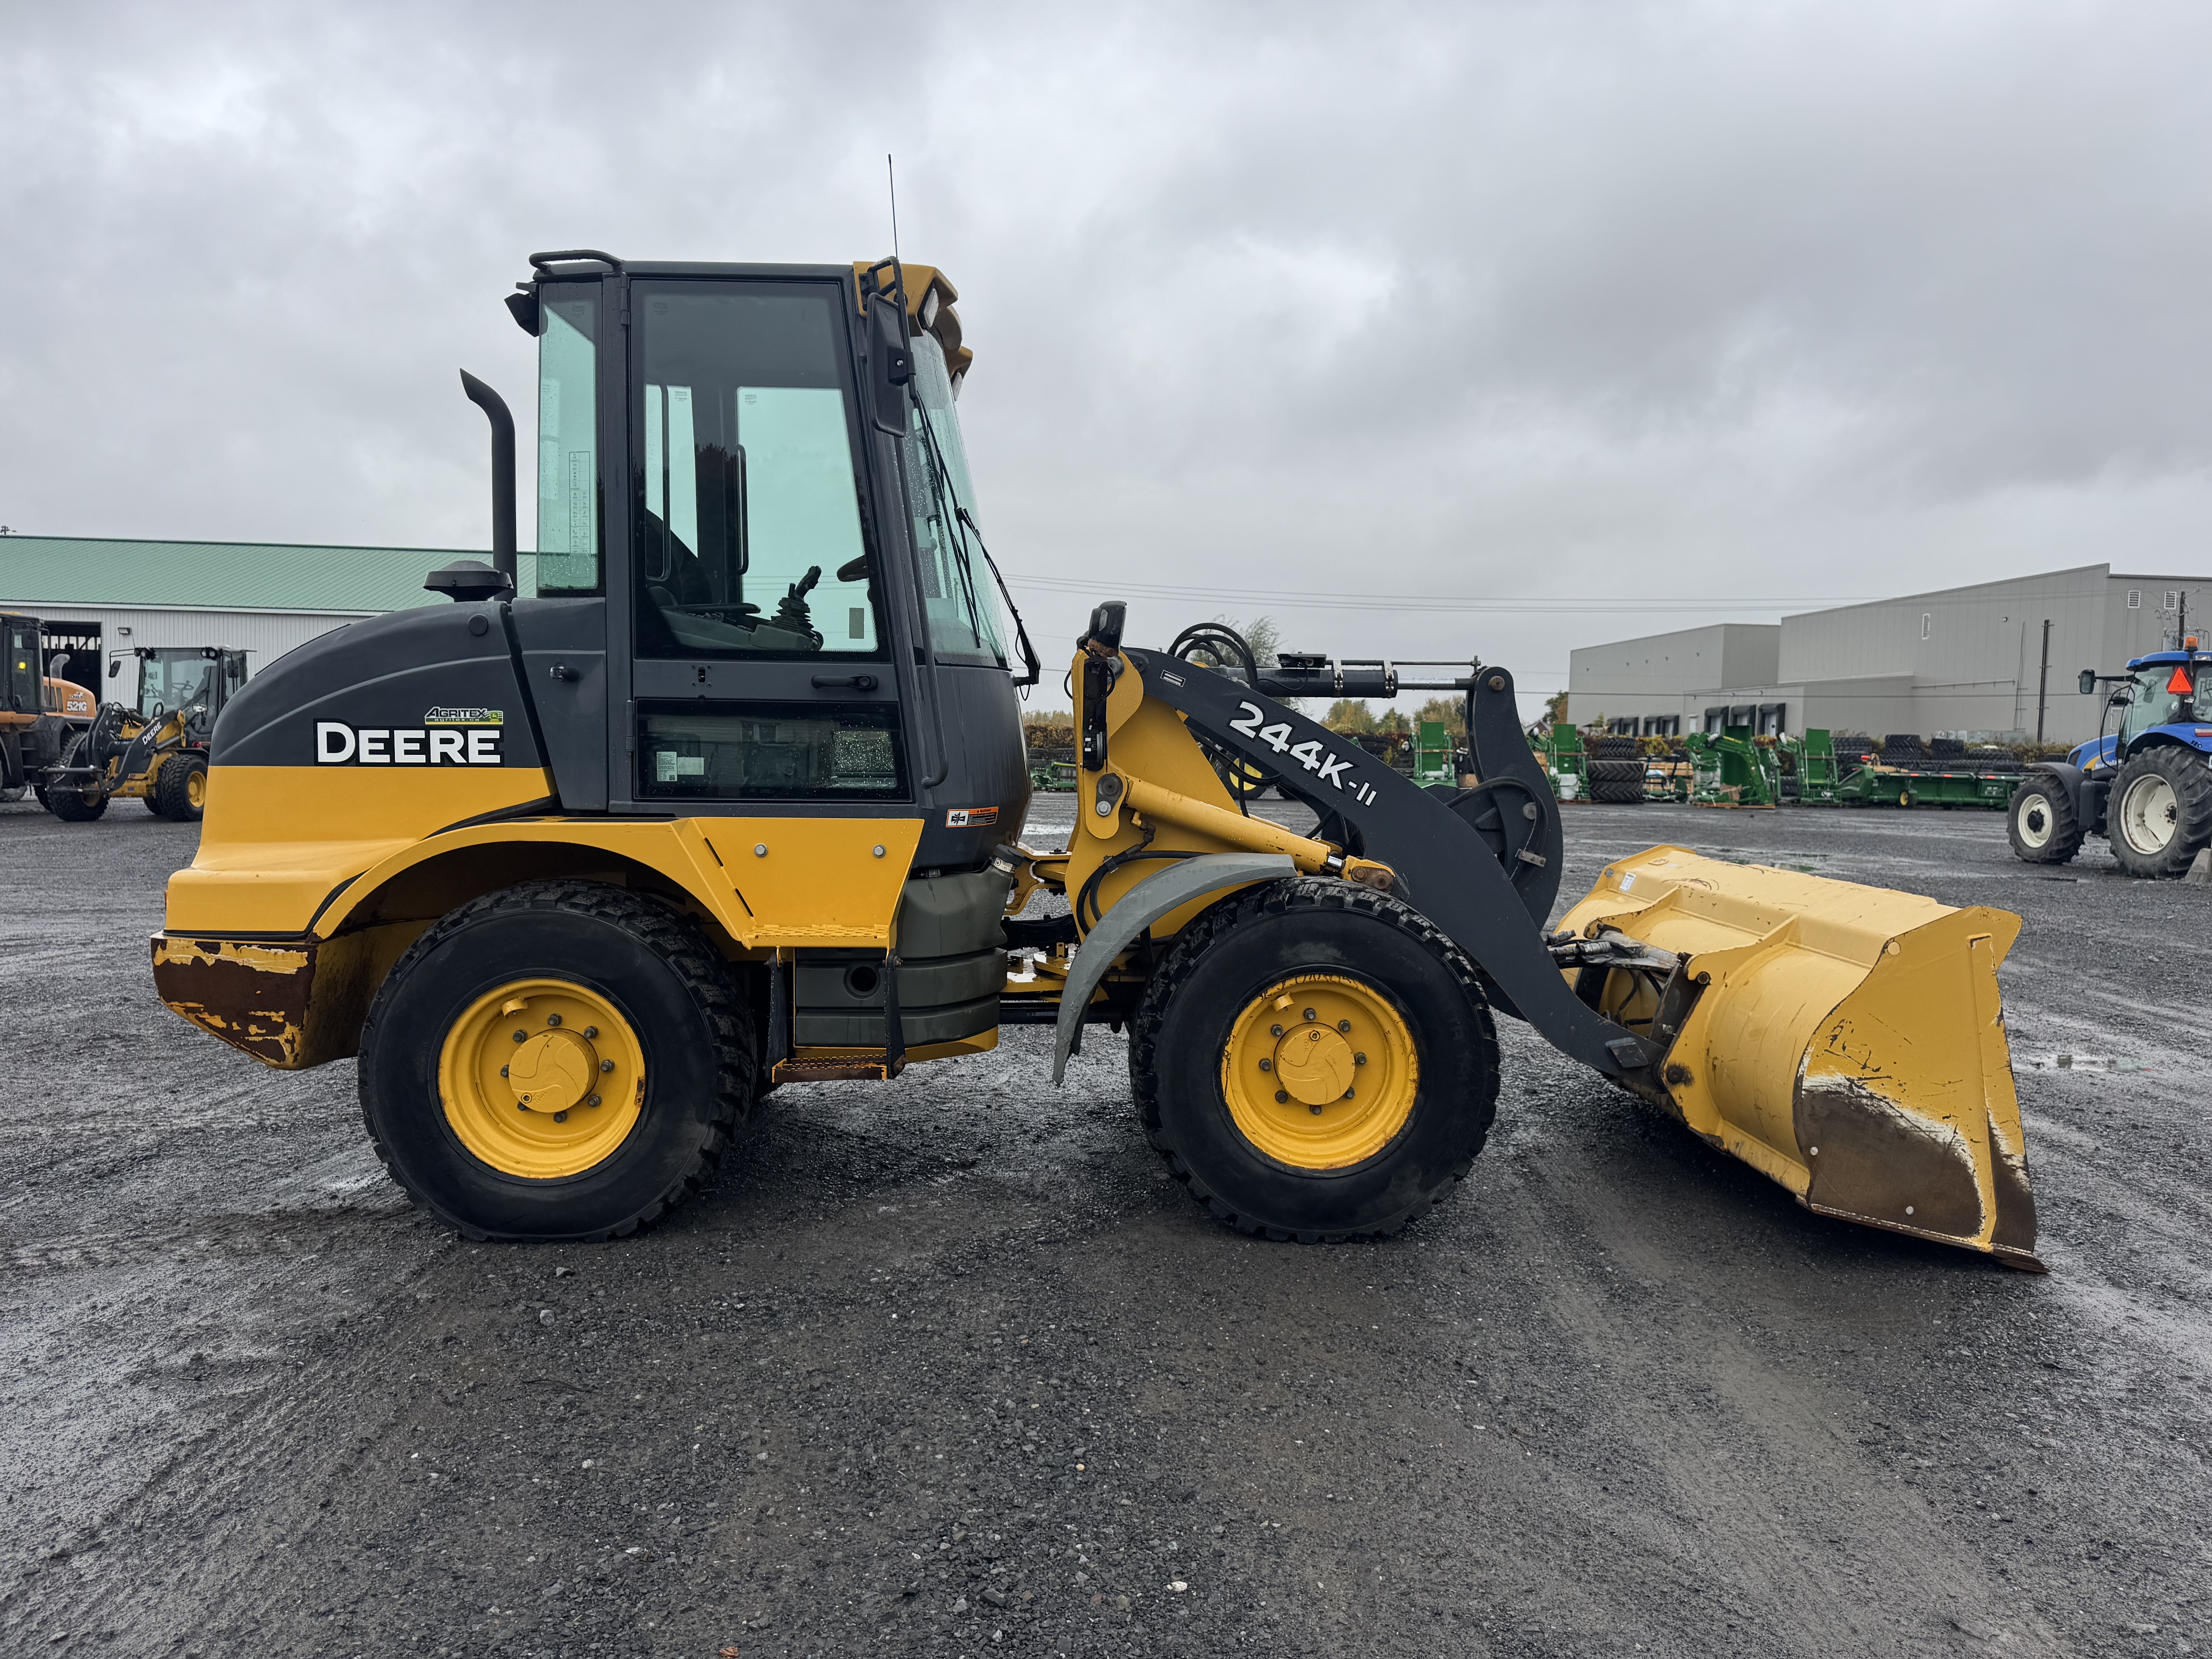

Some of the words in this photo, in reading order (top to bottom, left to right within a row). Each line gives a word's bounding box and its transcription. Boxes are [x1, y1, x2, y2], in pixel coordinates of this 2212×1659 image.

[67, 701, 87, 712] 521G
[426, 708, 486, 717] AGRITEX
[142, 721, 162, 745] DEERE
[317, 722, 500, 763] DEERE
[1230, 701, 1377, 806] 244K-II
